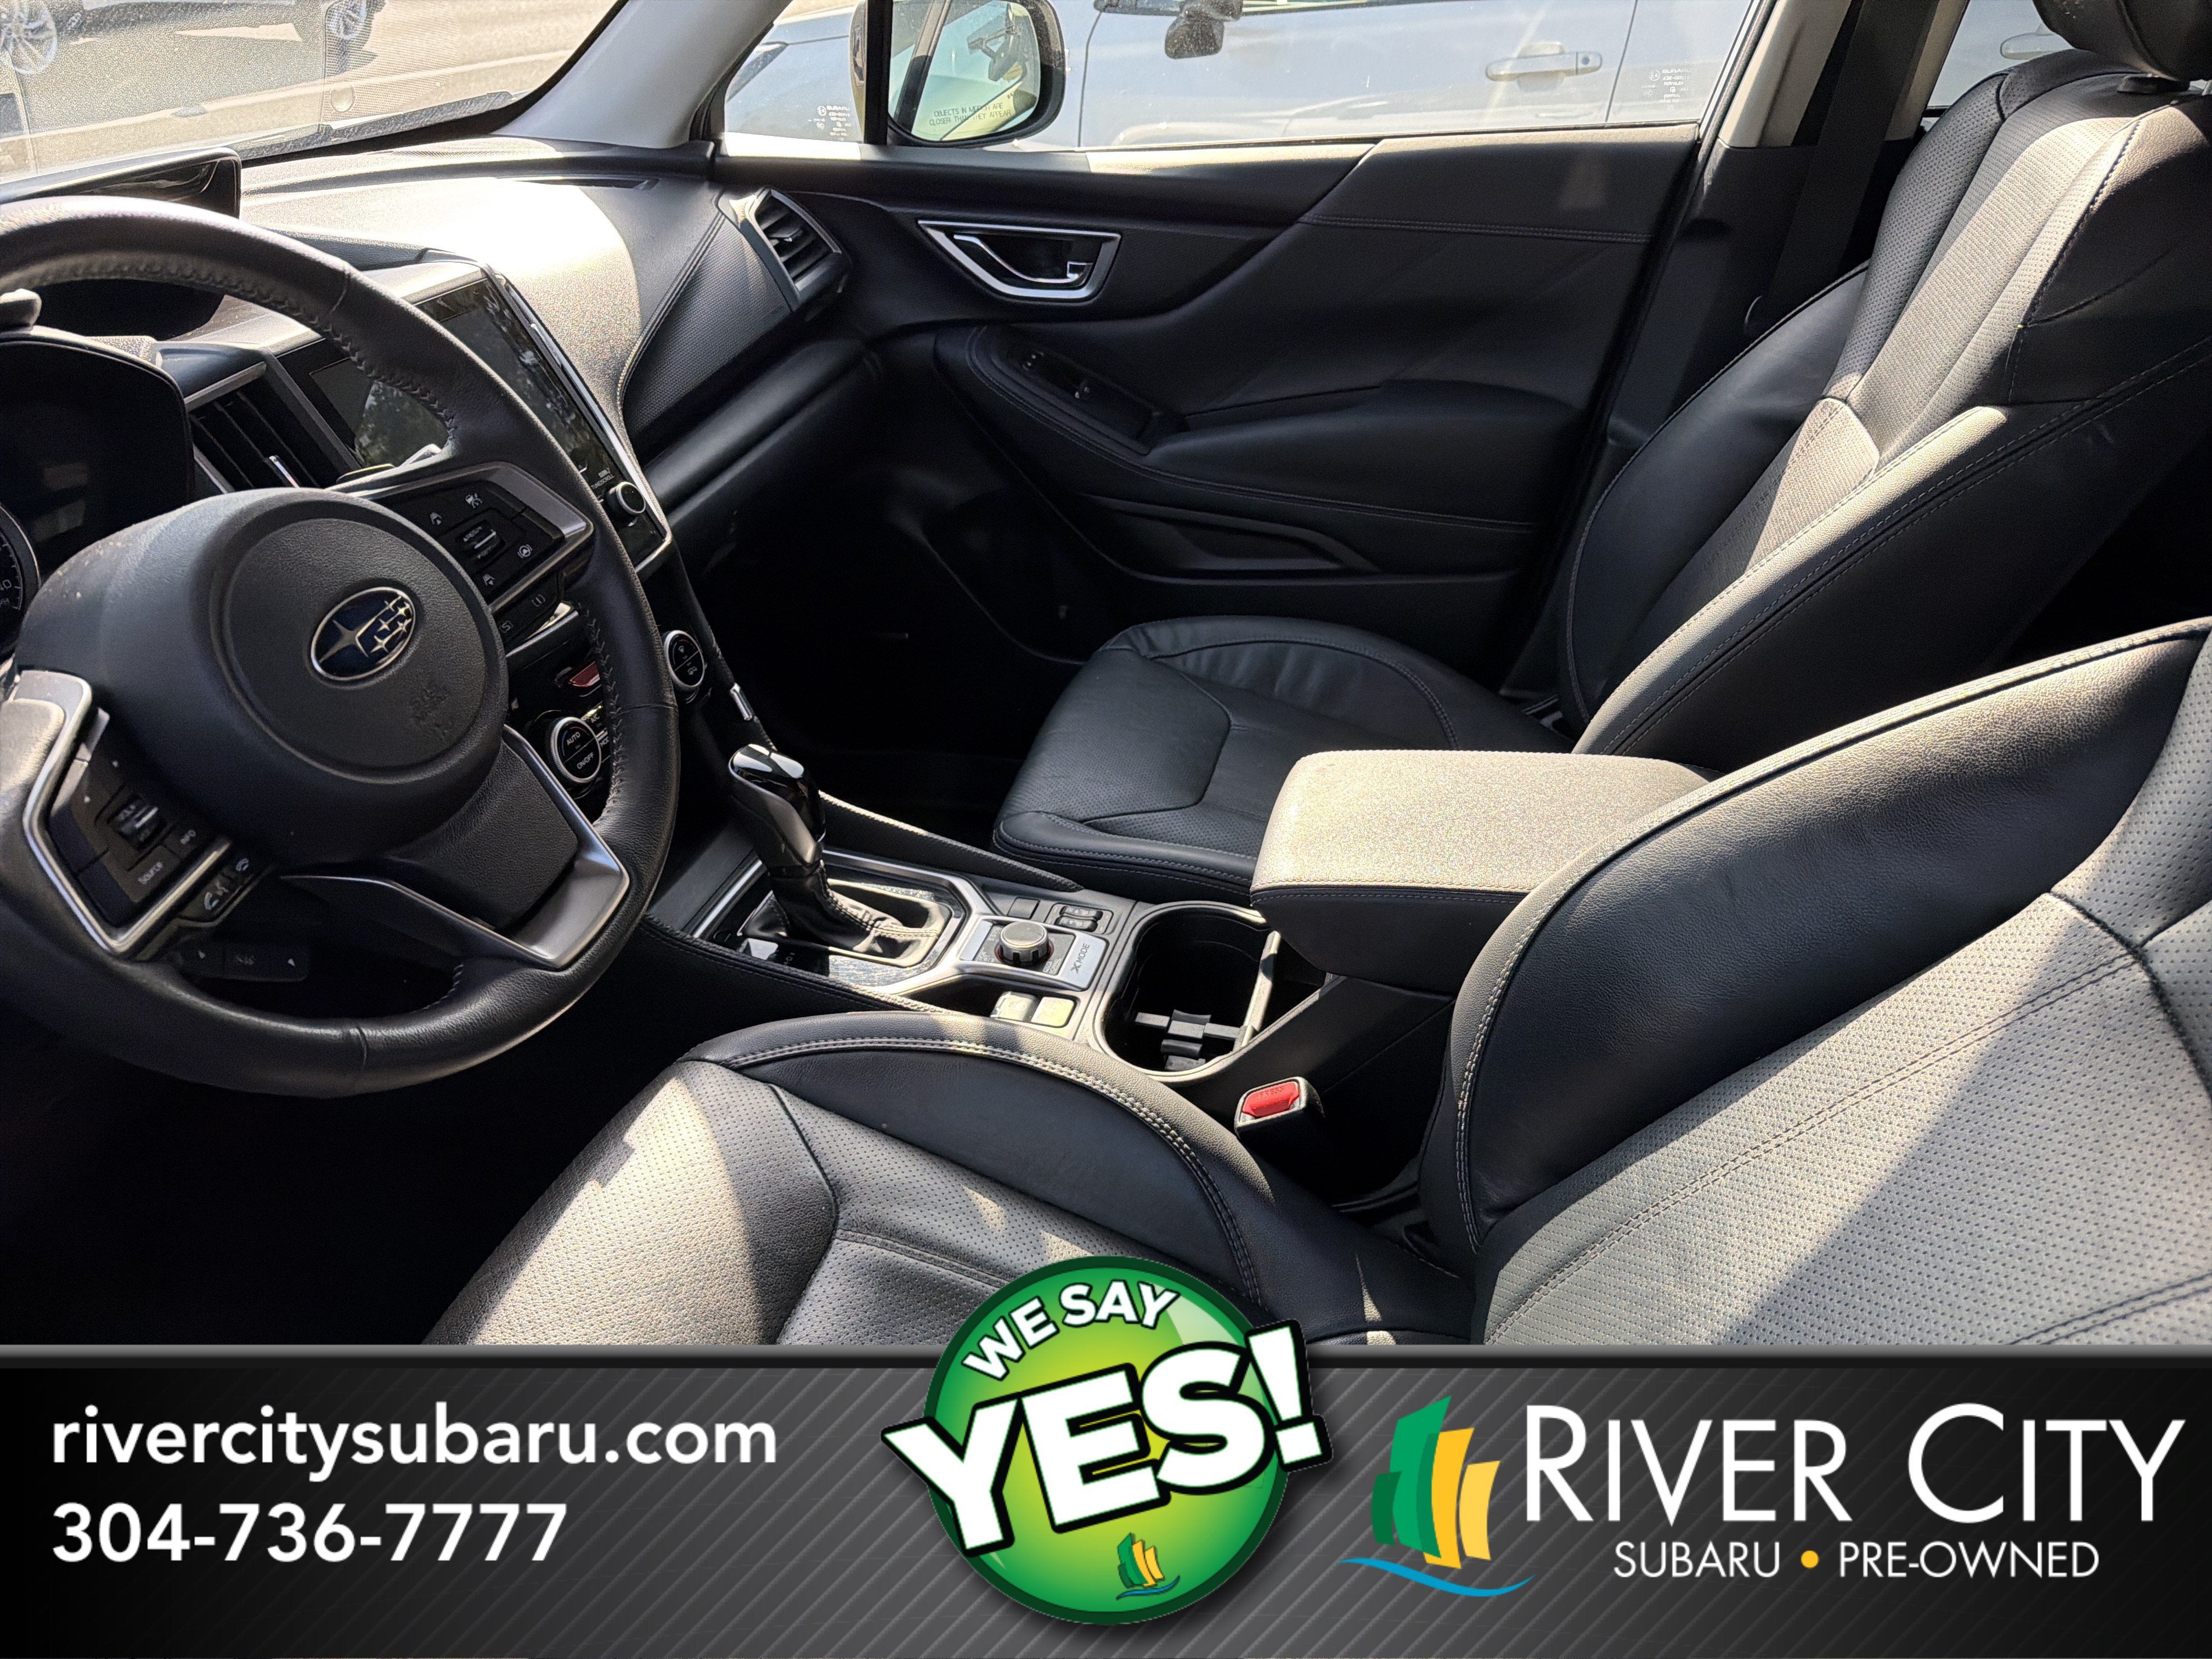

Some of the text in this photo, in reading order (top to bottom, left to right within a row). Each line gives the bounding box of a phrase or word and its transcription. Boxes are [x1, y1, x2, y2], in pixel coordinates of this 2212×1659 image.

[929, 117, 952, 126] CLOSER
[989, 110, 1012, 119] APPEAR
[934, 108, 960, 117] OBJECTS
[566, 731, 581, 746] AUTO
[577, 752, 594, 770] ON/OFF
